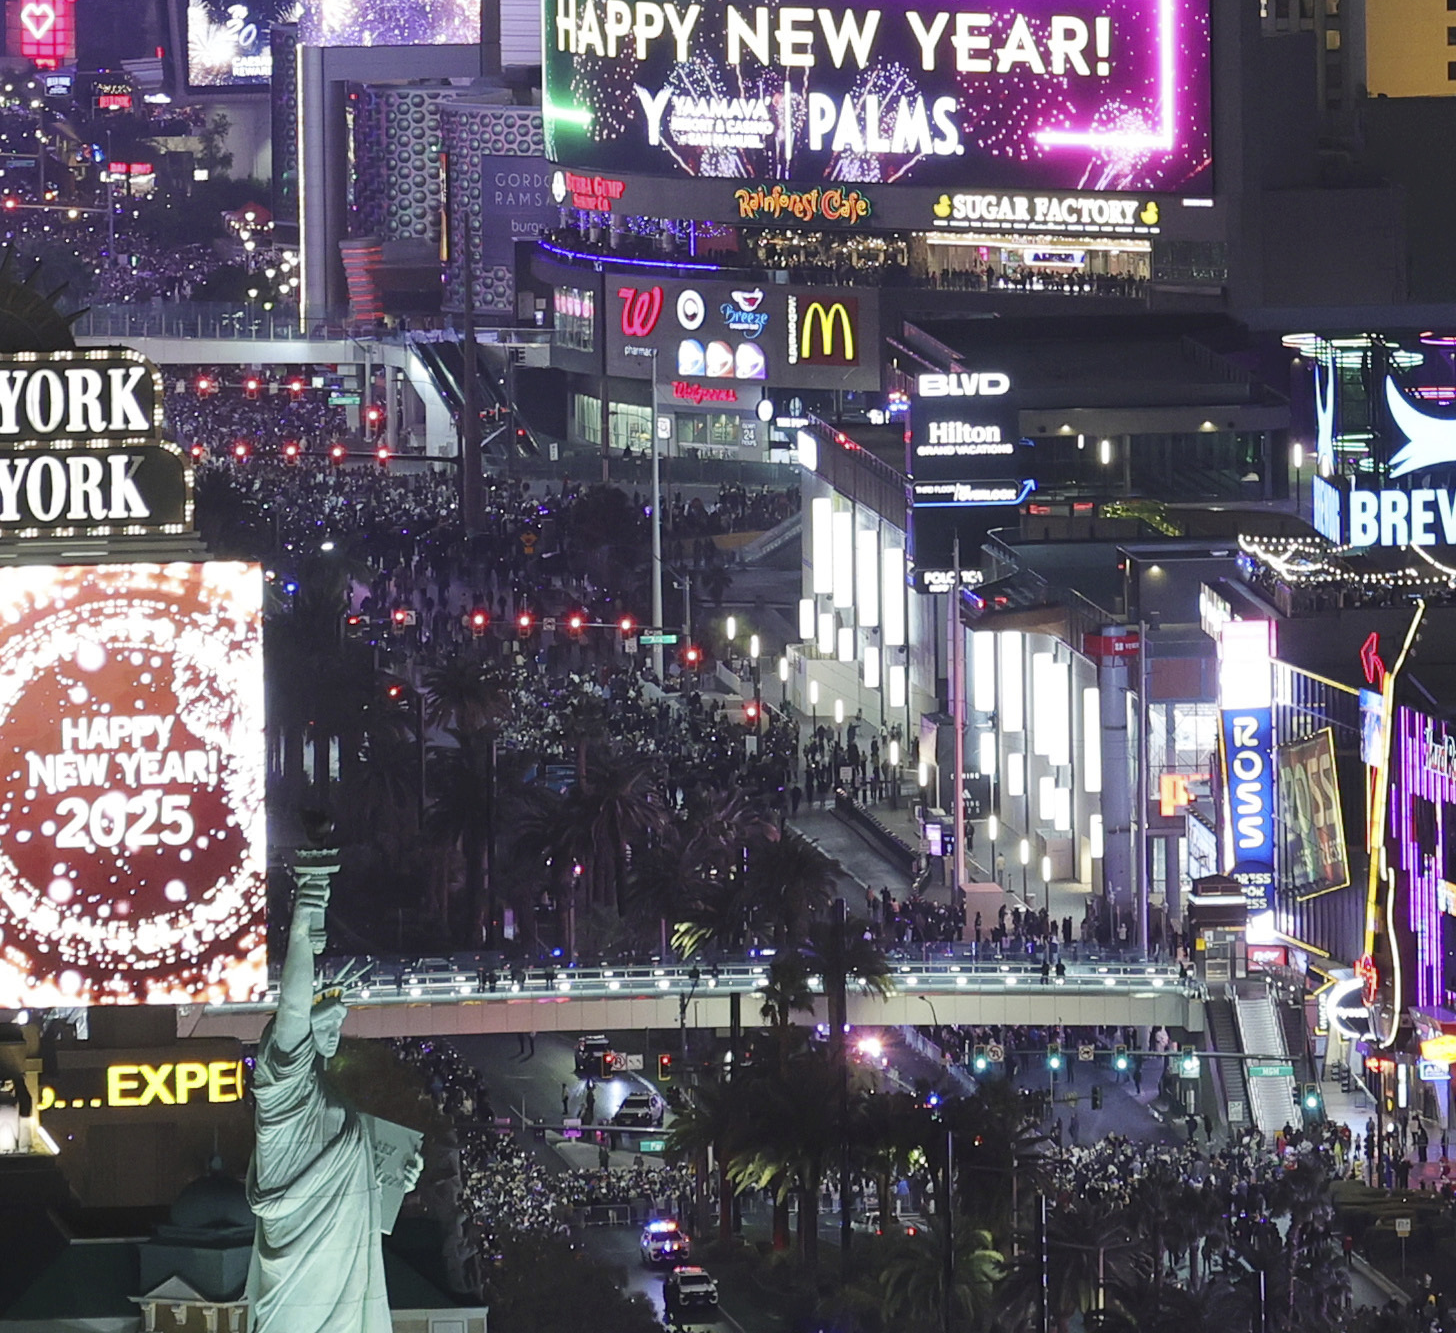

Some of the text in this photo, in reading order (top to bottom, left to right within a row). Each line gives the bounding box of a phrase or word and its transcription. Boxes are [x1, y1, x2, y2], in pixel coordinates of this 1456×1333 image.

[726, 7, 881, 69] NEW
[905, 10, 1113, 77] YEAR!
[808, 92, 965, 156] PALMS.
[594, 174, 626, 198] GUMP
[735, 185, 818, 222] Rainforest
[953, 194, 1139, 225] SUGAR FACTORY
[720, 303, 768, 339] Breeze
[671, 380, 738, 405] Walgreens
[918, 372, 1011, 397] BLVD
[916, 443, 1014, 457] GRAND VACATIONS
[928, 420, 1001, 445] Hilton
[61, 715, 176, 758] HAPPY
[29, 751, 219, 793] NEW YEAR!
[1232, 716, 1265, 849] ROSS
[54, 795, 195, 853] 2025
